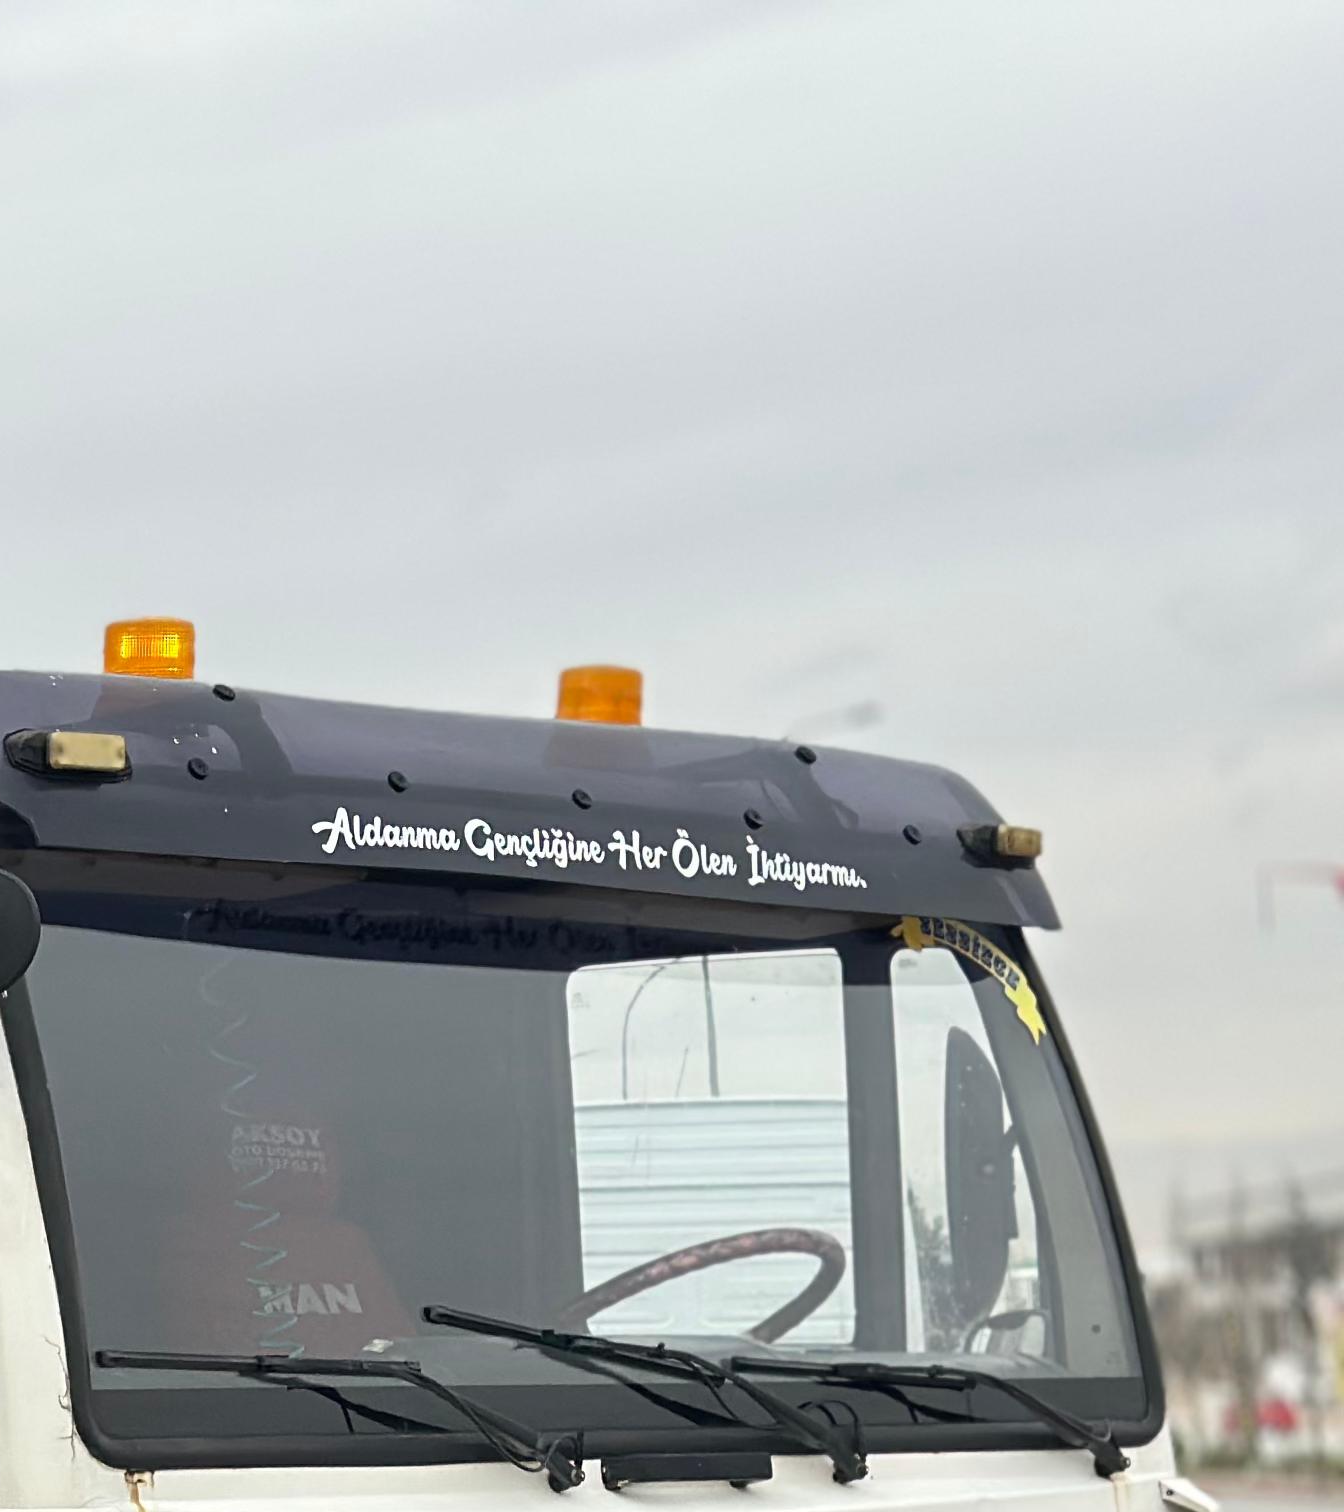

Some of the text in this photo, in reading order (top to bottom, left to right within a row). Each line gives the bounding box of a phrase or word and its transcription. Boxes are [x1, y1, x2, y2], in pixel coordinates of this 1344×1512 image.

[312, 806, 460, 854] Aldanma
[464, 818, 606, 868] Gençliğine
[608, 829, 668, 870] Her
[672, 828, 738, 878] Ölen
[257, 1282, 363, 1315] MAN
